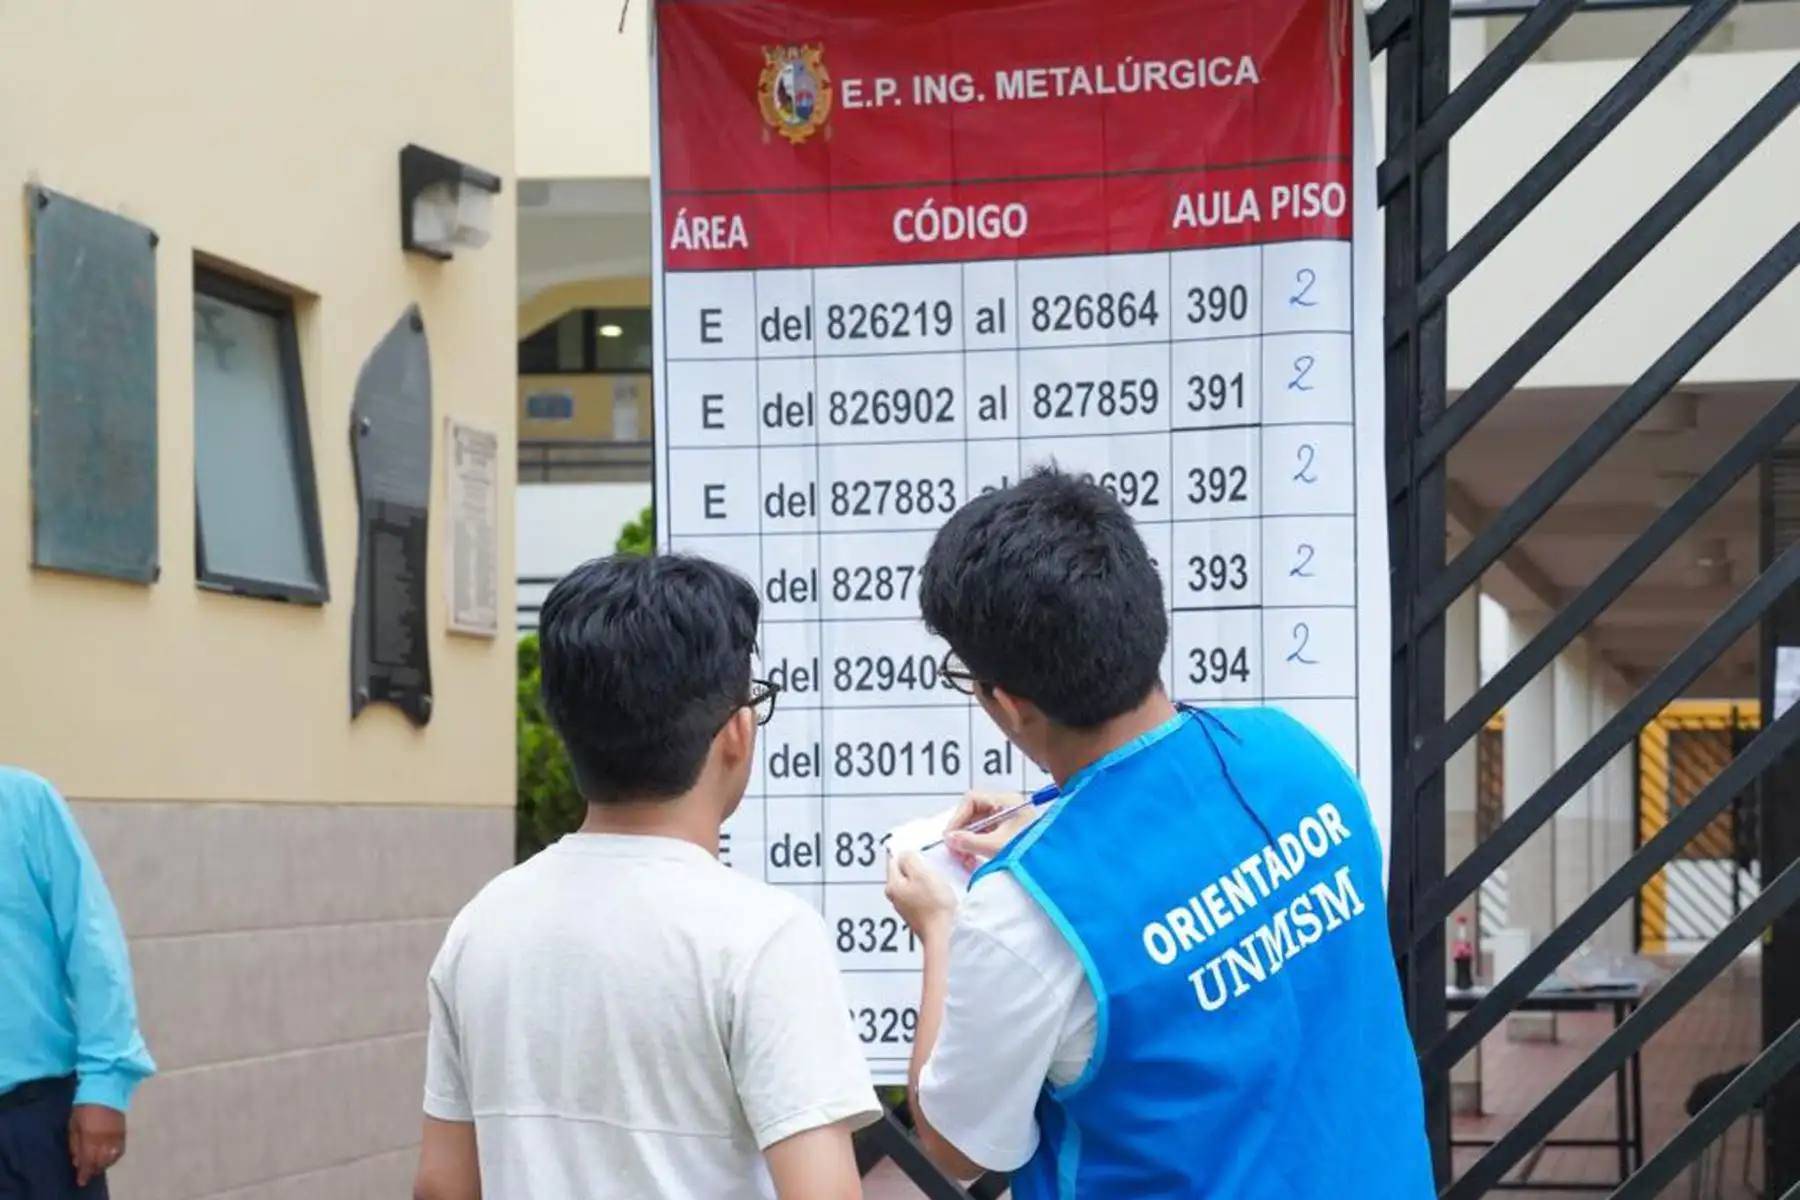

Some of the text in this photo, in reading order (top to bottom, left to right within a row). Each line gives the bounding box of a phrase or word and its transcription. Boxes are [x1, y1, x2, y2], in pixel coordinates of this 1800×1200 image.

[841, 55, 1259, 109] E.P. ING. METALÚRGICA
[670, 182, 1346, 251] ÁREA CÓDIGO AULA PISO
[1289, 268, 1318, 307] 2
[701, 284, 1248, 343] E del 826219 al 826864 390
[1288, 355, 1316, 391] 2
[703, 372, 1244, 429] E del 826902 al 827859 391
[1293, 444, 1317, 484] 2
[704, 484, 726, 519] E
[765, 482, 816, 518] del
[832, 478, 957, 517] 827883
[1081, 470, 1159, 507] 692
[1187, 465, 1248, 504] 392
[766, 554, 1248, 603] del 8287 393
[1289, 543, 1316, 577] 2
[1286, 622, 1320, 665] 2
[768, 657, 819, 693] del
[1188, 647, 1250, 684] 394
[769, 740, 1012, 778] del 830116 al
[770, 832, 821, 868] del
[1143, 803, 1351, 965] ORIENTADOR
[837, 917, 916, 953] 8321
[1188, 866, 1365, 1011] UNMSM
